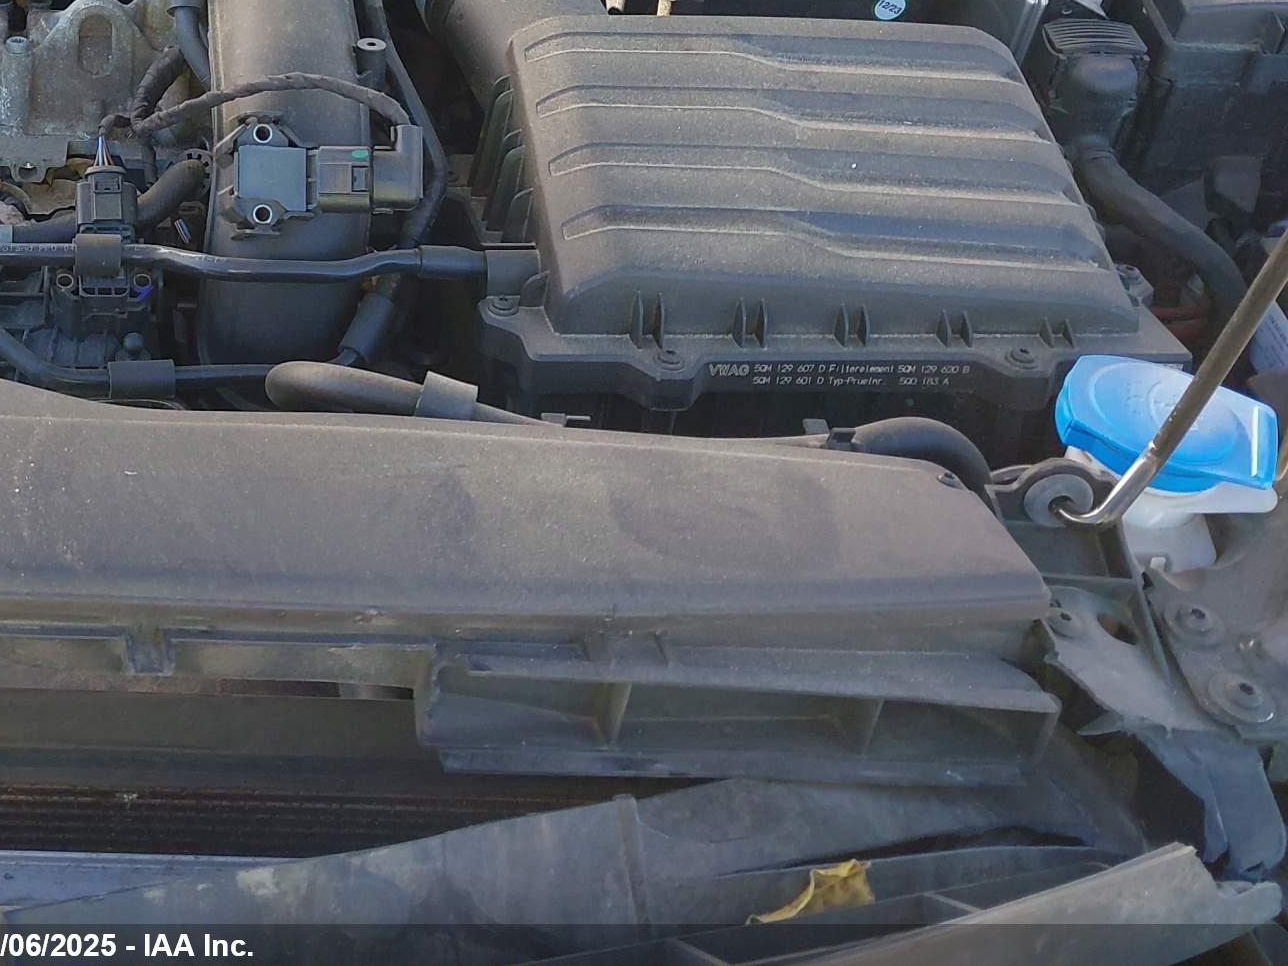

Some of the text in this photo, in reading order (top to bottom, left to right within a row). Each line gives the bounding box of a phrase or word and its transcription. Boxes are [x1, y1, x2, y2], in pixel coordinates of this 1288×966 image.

[878, 0, 903, 15] 12/23
[778, 364, 794, 372] 129
[797, 364, 815, 372] 607
[818, 364, 826, 373] D
[921, 364, 938, 374] 129
[940, 365, 959, 374] 620
[962, 365, 970, 374] B
[776, 376, 793, 384] 129
[796, 376, 812, 384] 601
[816, 376, 825, 384] D
[942, 378, 950, 386] A
